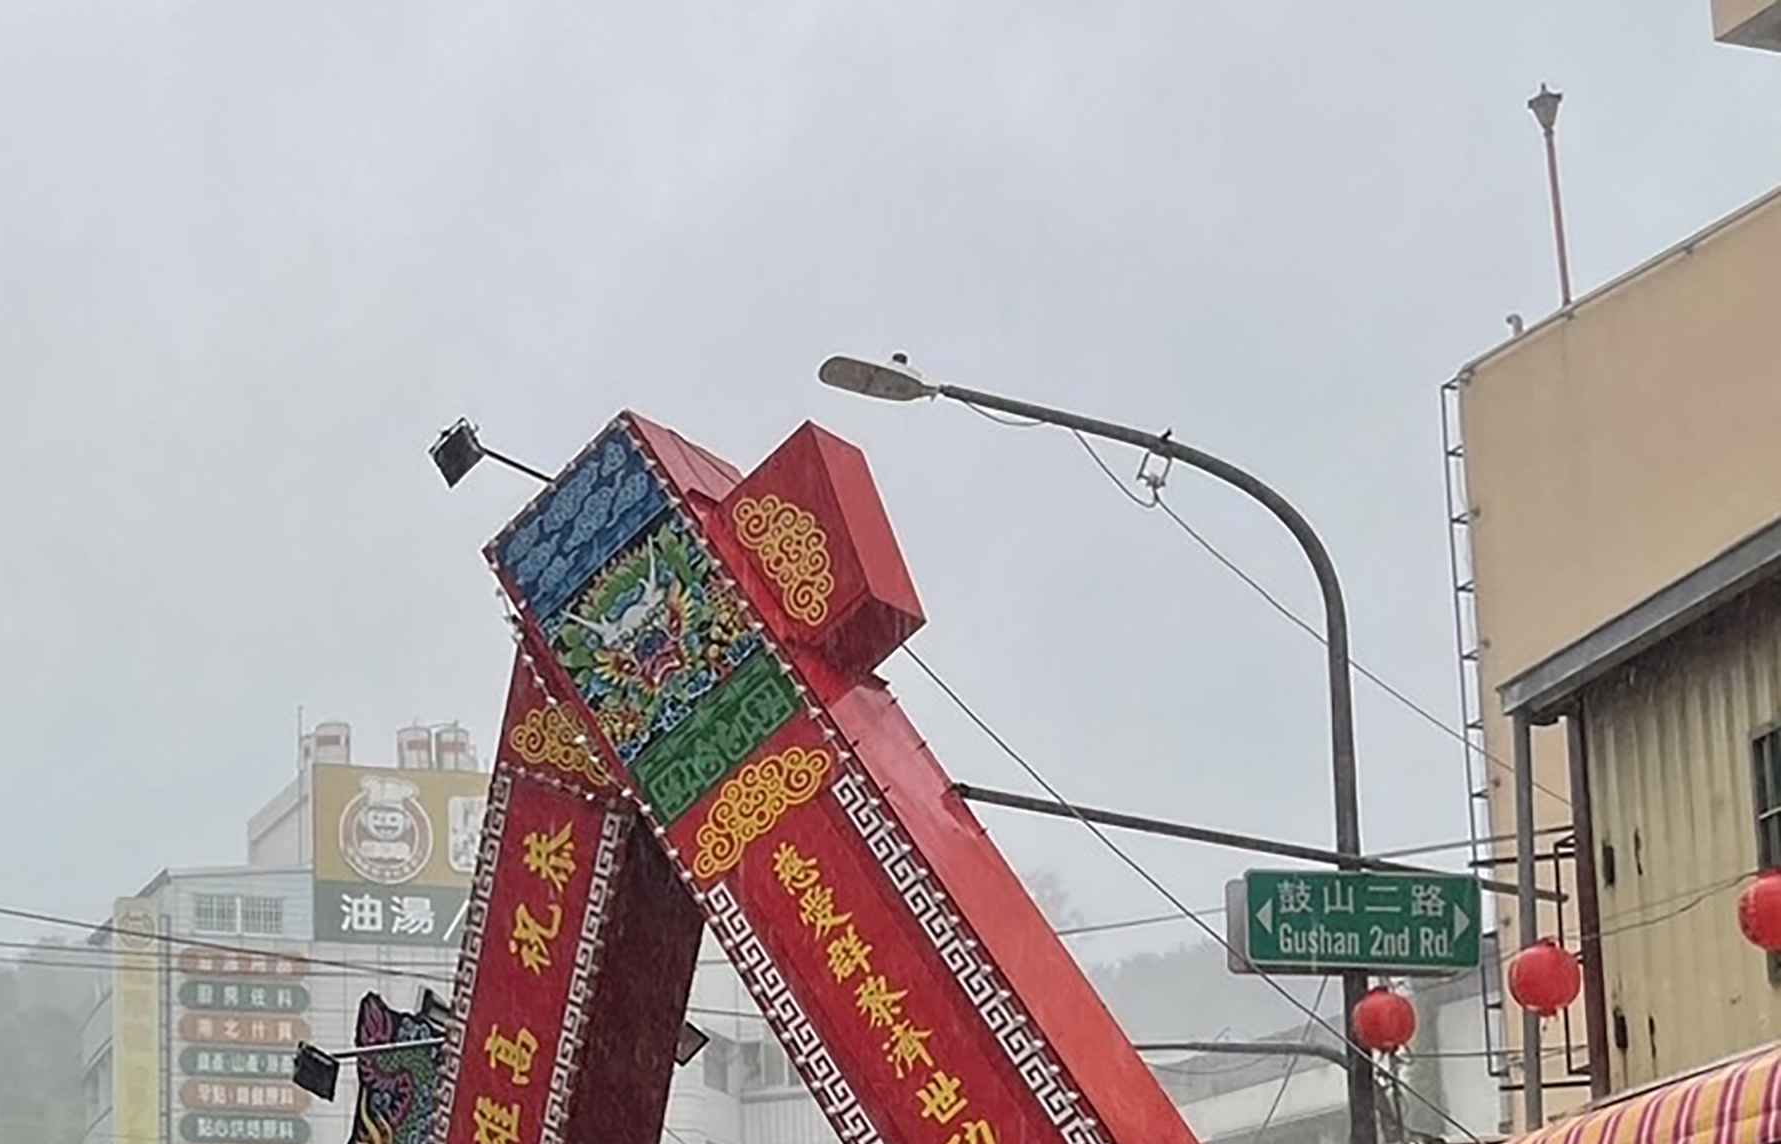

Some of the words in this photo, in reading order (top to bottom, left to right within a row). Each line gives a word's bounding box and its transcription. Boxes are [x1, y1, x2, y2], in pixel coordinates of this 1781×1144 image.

[1276, 879, 1446, 917] 鼓山二路
[1278, 922, 1360, 956] Gushan
[1370, 925, 1410, 957] 2nd
